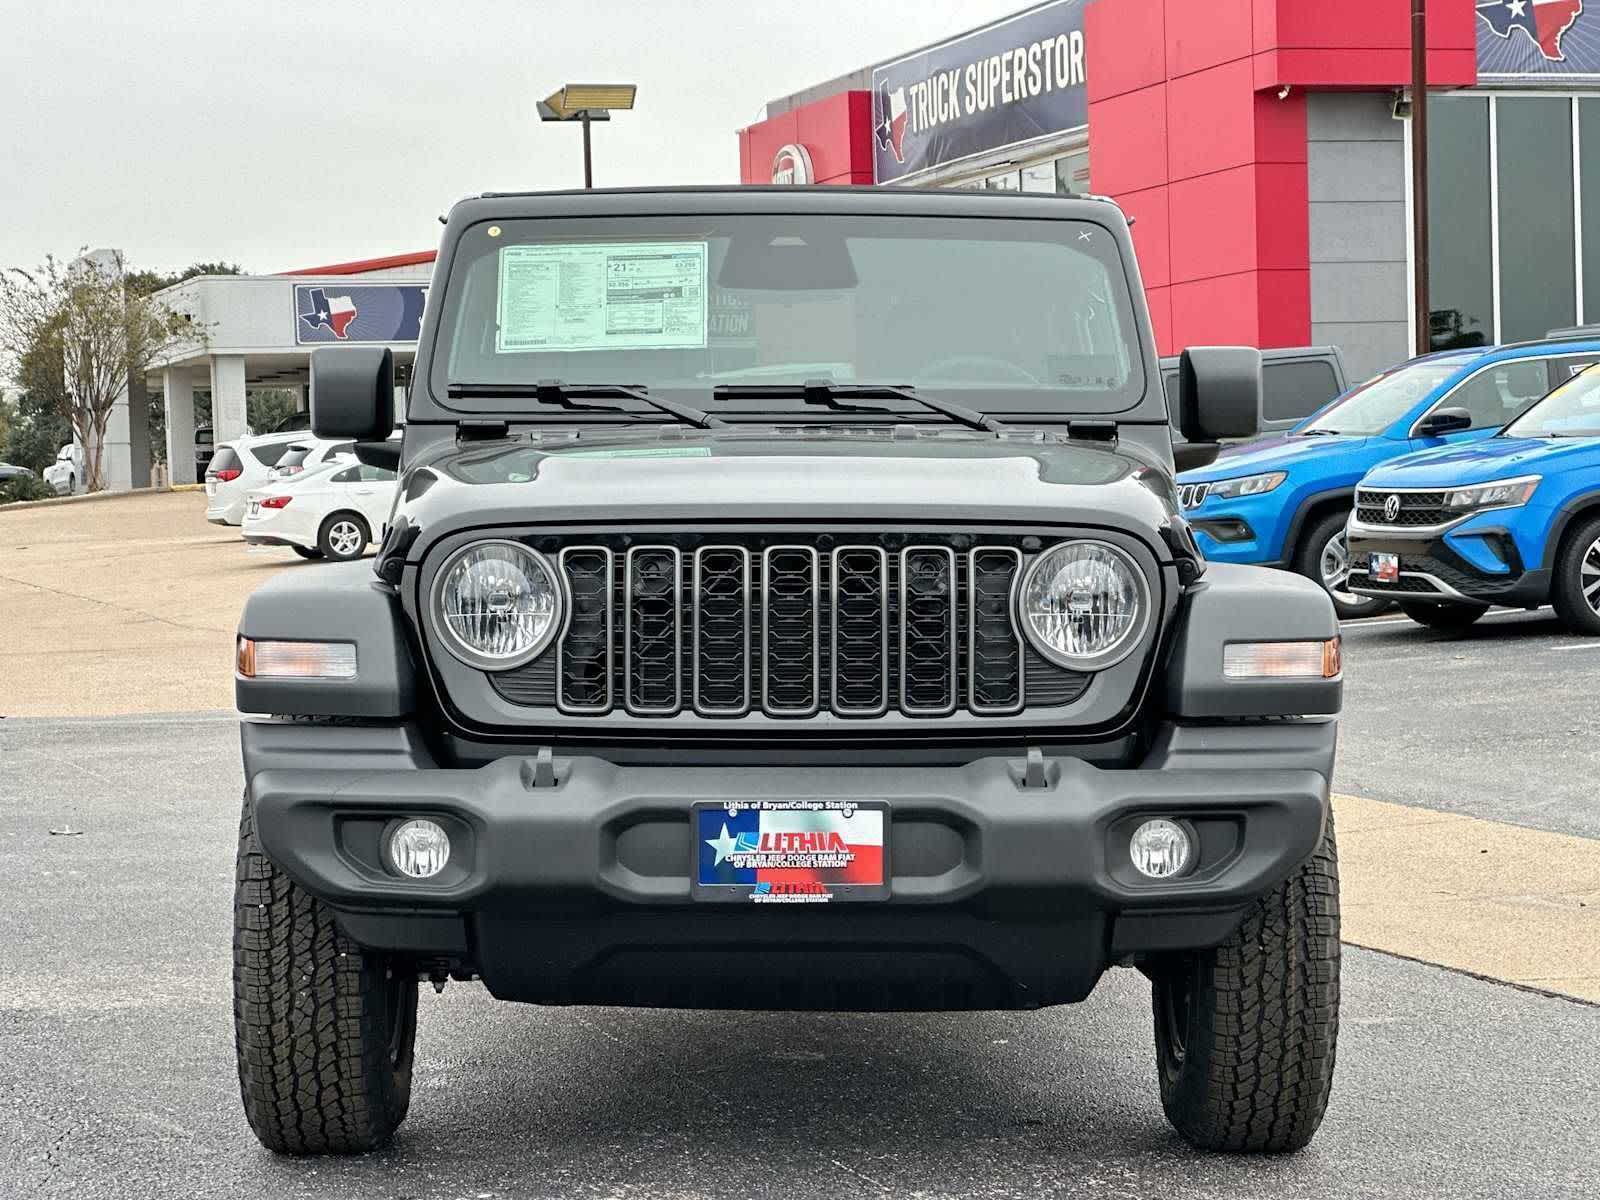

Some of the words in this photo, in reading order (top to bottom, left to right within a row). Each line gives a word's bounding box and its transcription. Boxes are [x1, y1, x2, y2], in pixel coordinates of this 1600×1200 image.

[910, 68, 960, 133] TRUCK
[965, 30, 1088, 115] SUPERSTOR
[723, 801, 749, 810] Lithia
[751, 801, 761, 809] of
[762, 801, 824, 811] Bryan/College
[825, 801, 858, 809] Station
[759, 831, 850, 854] LITHIA
[725, 854, 767, 862] CHRYSLER
[838, 853, 856, 861] FIAT
